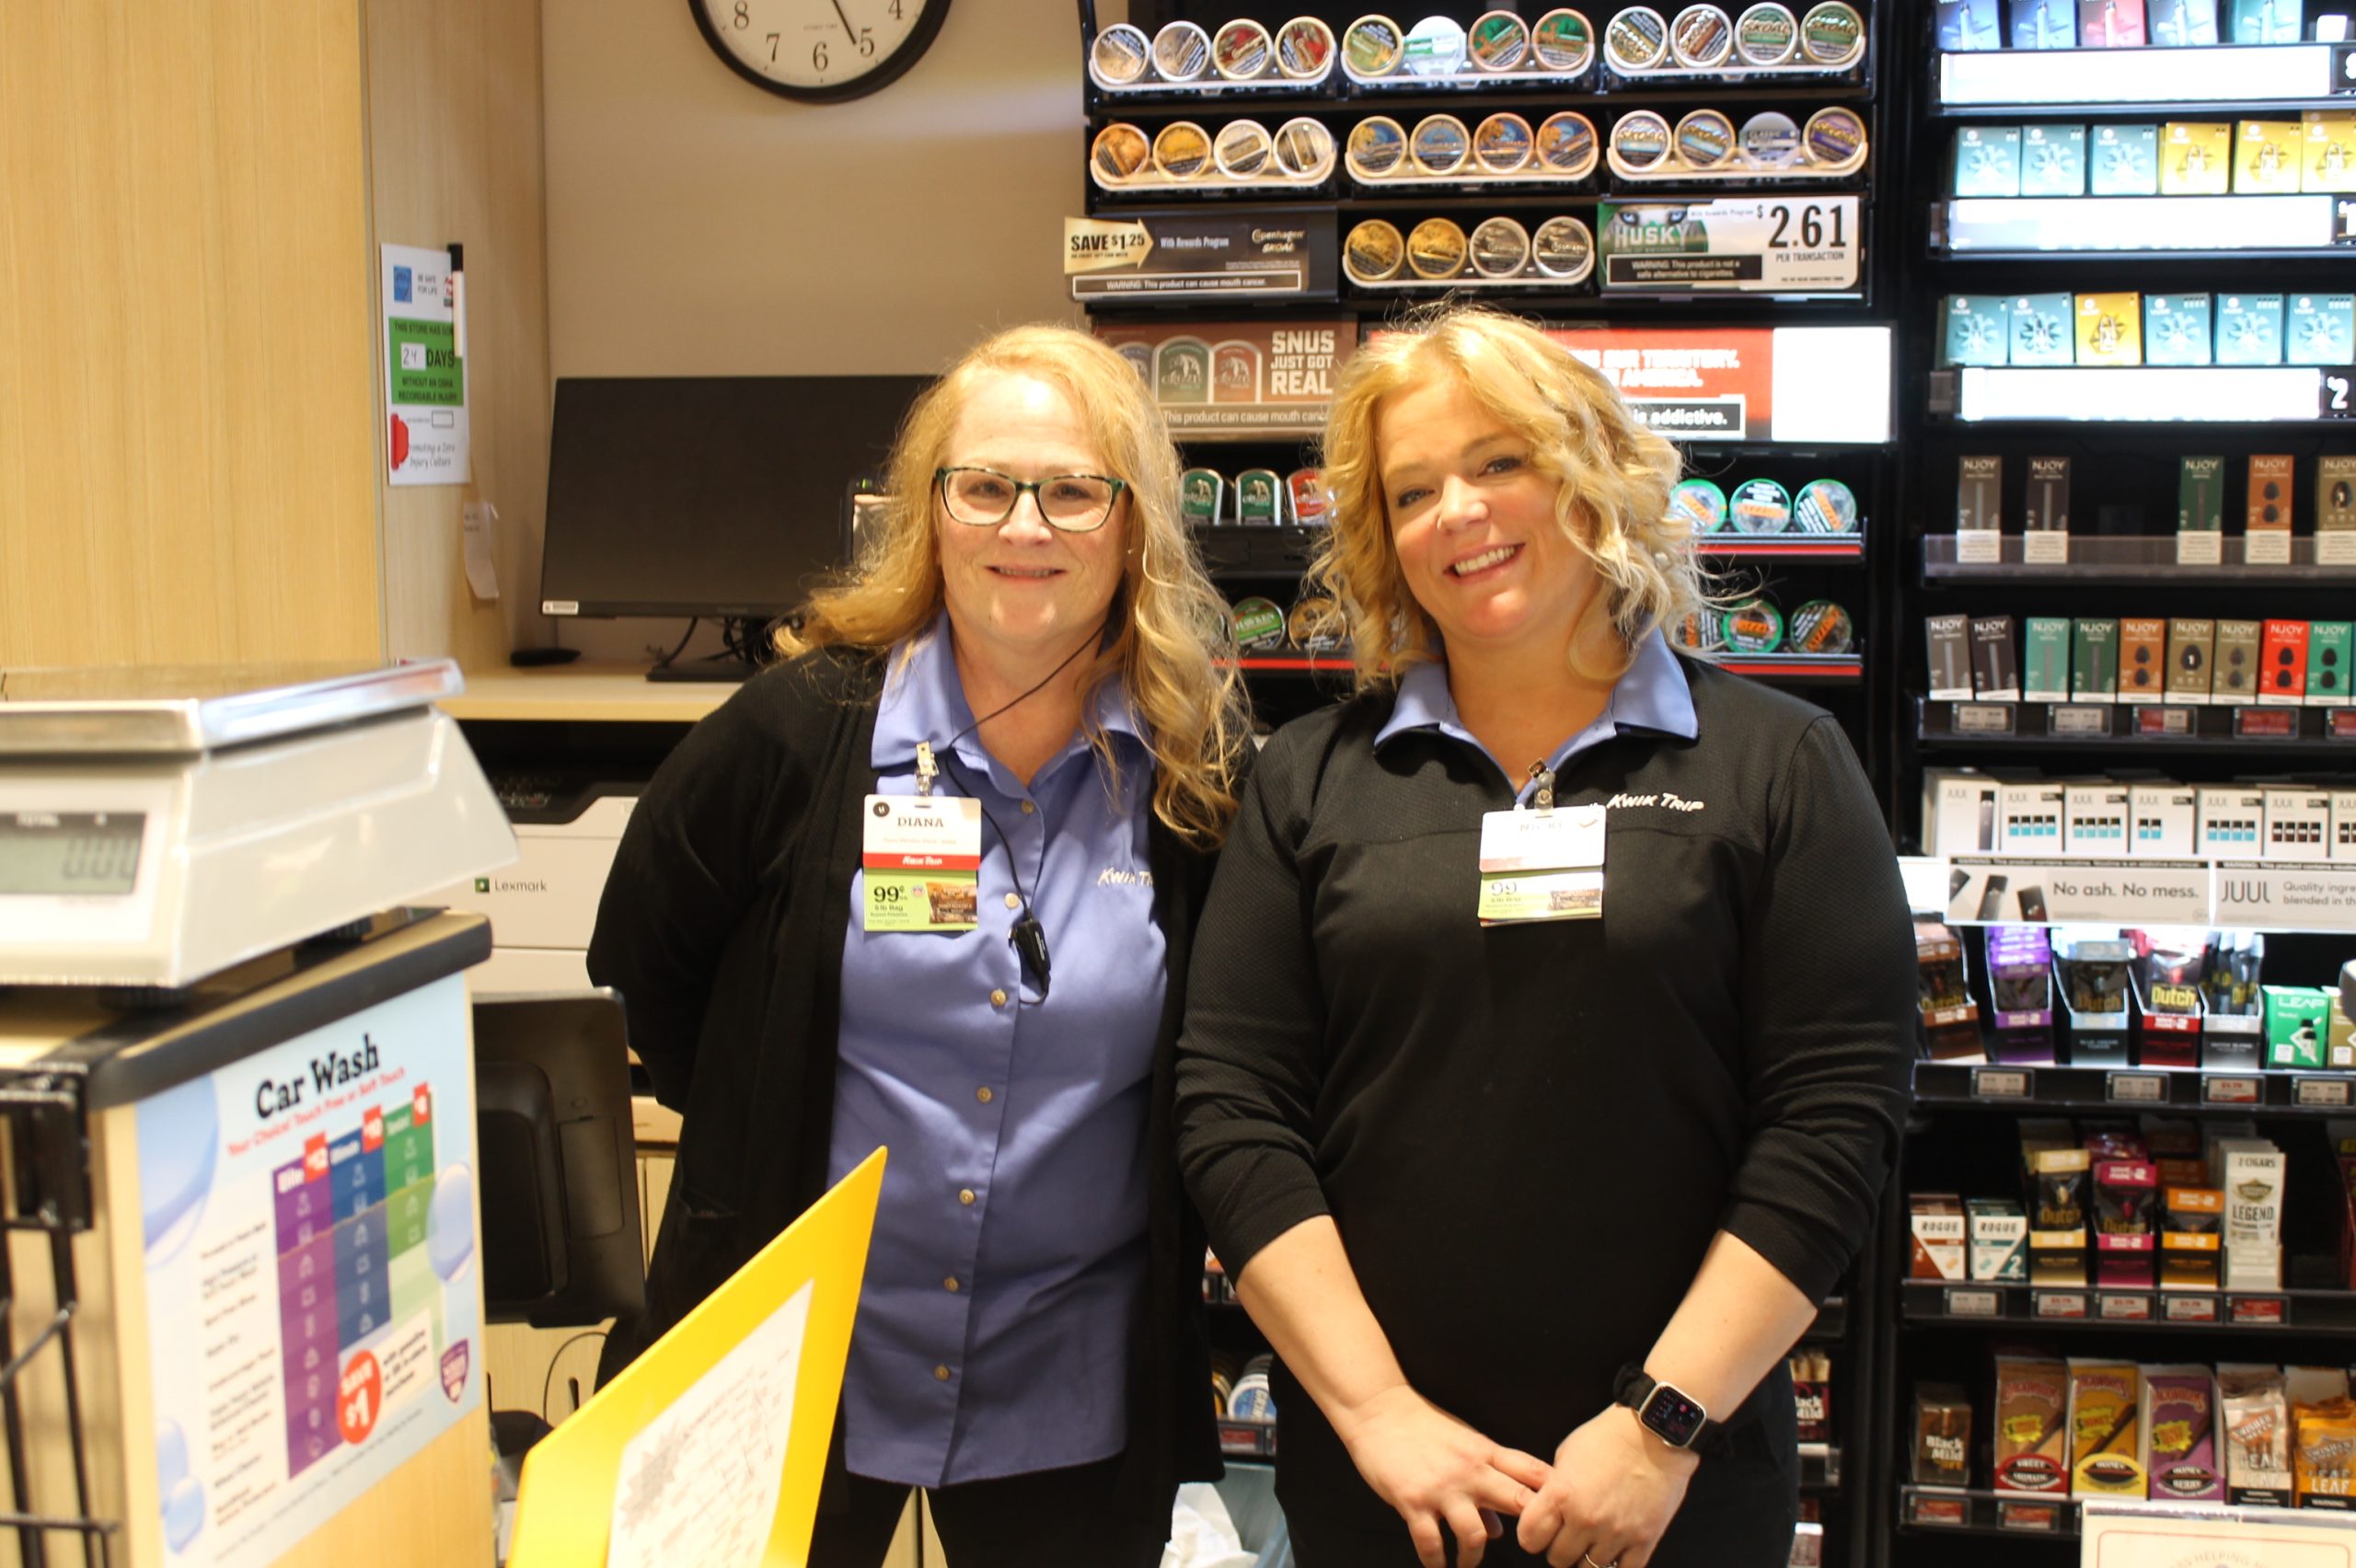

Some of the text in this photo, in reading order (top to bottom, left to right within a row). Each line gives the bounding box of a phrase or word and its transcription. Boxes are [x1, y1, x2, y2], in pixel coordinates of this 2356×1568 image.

[734, 2, 749, 29] 8
[888, 0, 903, 20] 4
[766, 33, 780, 62] 7
[860, 28, 874, 57] 5
[813, 42, 827, 71] 6
[1613, 222, 1690, 249] HUSKY
[1071, 234, 1145, 251] SAVE $1.25
[1776, 250, 1844, 262] PER TRANSACTION
[1687, 260, 1714, 270] product
[1160, 279, 1184, 290] product
[1199, 279, 1218, 287] cause
[1219, 278, 1242, 287] mouth
[1272, 330, 1334, 353] SNUS
[426, 348, 455, 368] DAYS
[1271, 355, 1334, 369] JUST GOT
[1271, 370, 1334, 395] REAL
[398, 390, 437, 401] RECORDABLE
[1164, 410, 1329, 425] This product can cause mouth canc
[1634, 409, 1727, 424] is addictive.
[410, 443, 435, 457] romoting
[1964, 460, 1997, 470] NJOY
[2032, 460, 2066, 471] NJOY
[2185, 460, 2218, 471] NJOY
[2255, 459, 2288, 469] NJOY
[1931, 619, 1962, 631] NJOY
[1975, 620, 2006, 633] NJOY
[2033, 623, 2064, 632] NJOY
[2080, 623, 2113, 633] NJOY
[2126, 623, 2157, 633] NJOY
[2177, 623, 2208, 633] NJOY
[2222, 624, 2254, 634] NJOY
[2270, 625, 2303, 635] NJOY
[2315, 625, 2347, 635] NJOY
[2339, 799, 2356, 809] JUU
[897, 816, 944, 828] DIANA
[494, 879, 548, 892] Lexmark
[2053, 882, 2199, 898] No ash. No mess.
[2283, 882, 2323, 893] Quality
[2221, 881, 2270, 904] JUUL
[2283, 894, 2328, 905] blended
[2332, 895, 2342, 905] in
[2151, 985, 2197, 1007] Dutch
[2278, 996, 2326, 1009] LEAP
[256, 1033, 379, 1119] Car Wash
[2246, 1158, 2275, 1168] CIGARS
[2232, 1205, 2274, 1221] LEGEND
[1922, 1222, 1958, 1232] ROGUE
[1980, 1222, 2016, 1233] ROGUE
[1795, 1395, 1822, 1408] lack
[1925, 1435, 1964, 1449] Black
[1931, 1447, 1965, 1461] Mild
[2173, 1480, 2201, 1489] BERRY
[2311, 1477, 2350, 1494] LEAF
